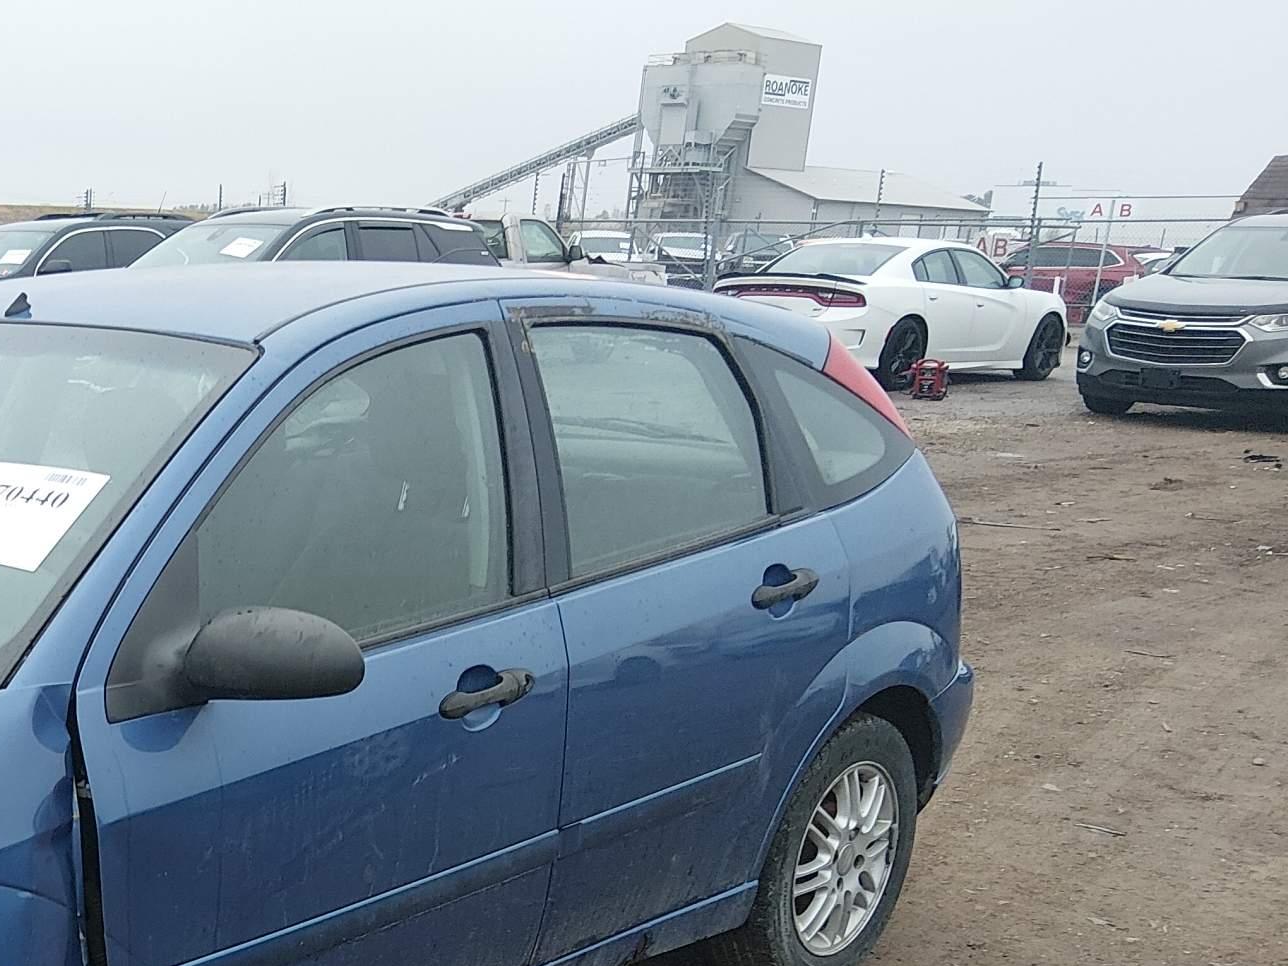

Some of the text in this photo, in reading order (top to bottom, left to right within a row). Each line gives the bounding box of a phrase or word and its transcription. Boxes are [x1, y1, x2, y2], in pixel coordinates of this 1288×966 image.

[765, 80, 809, 96] ROANOKE
[1090, 203, 1103, 217] A
[1119, 204, 1132, 217] B
[976, 237, 1008, 257] A B
